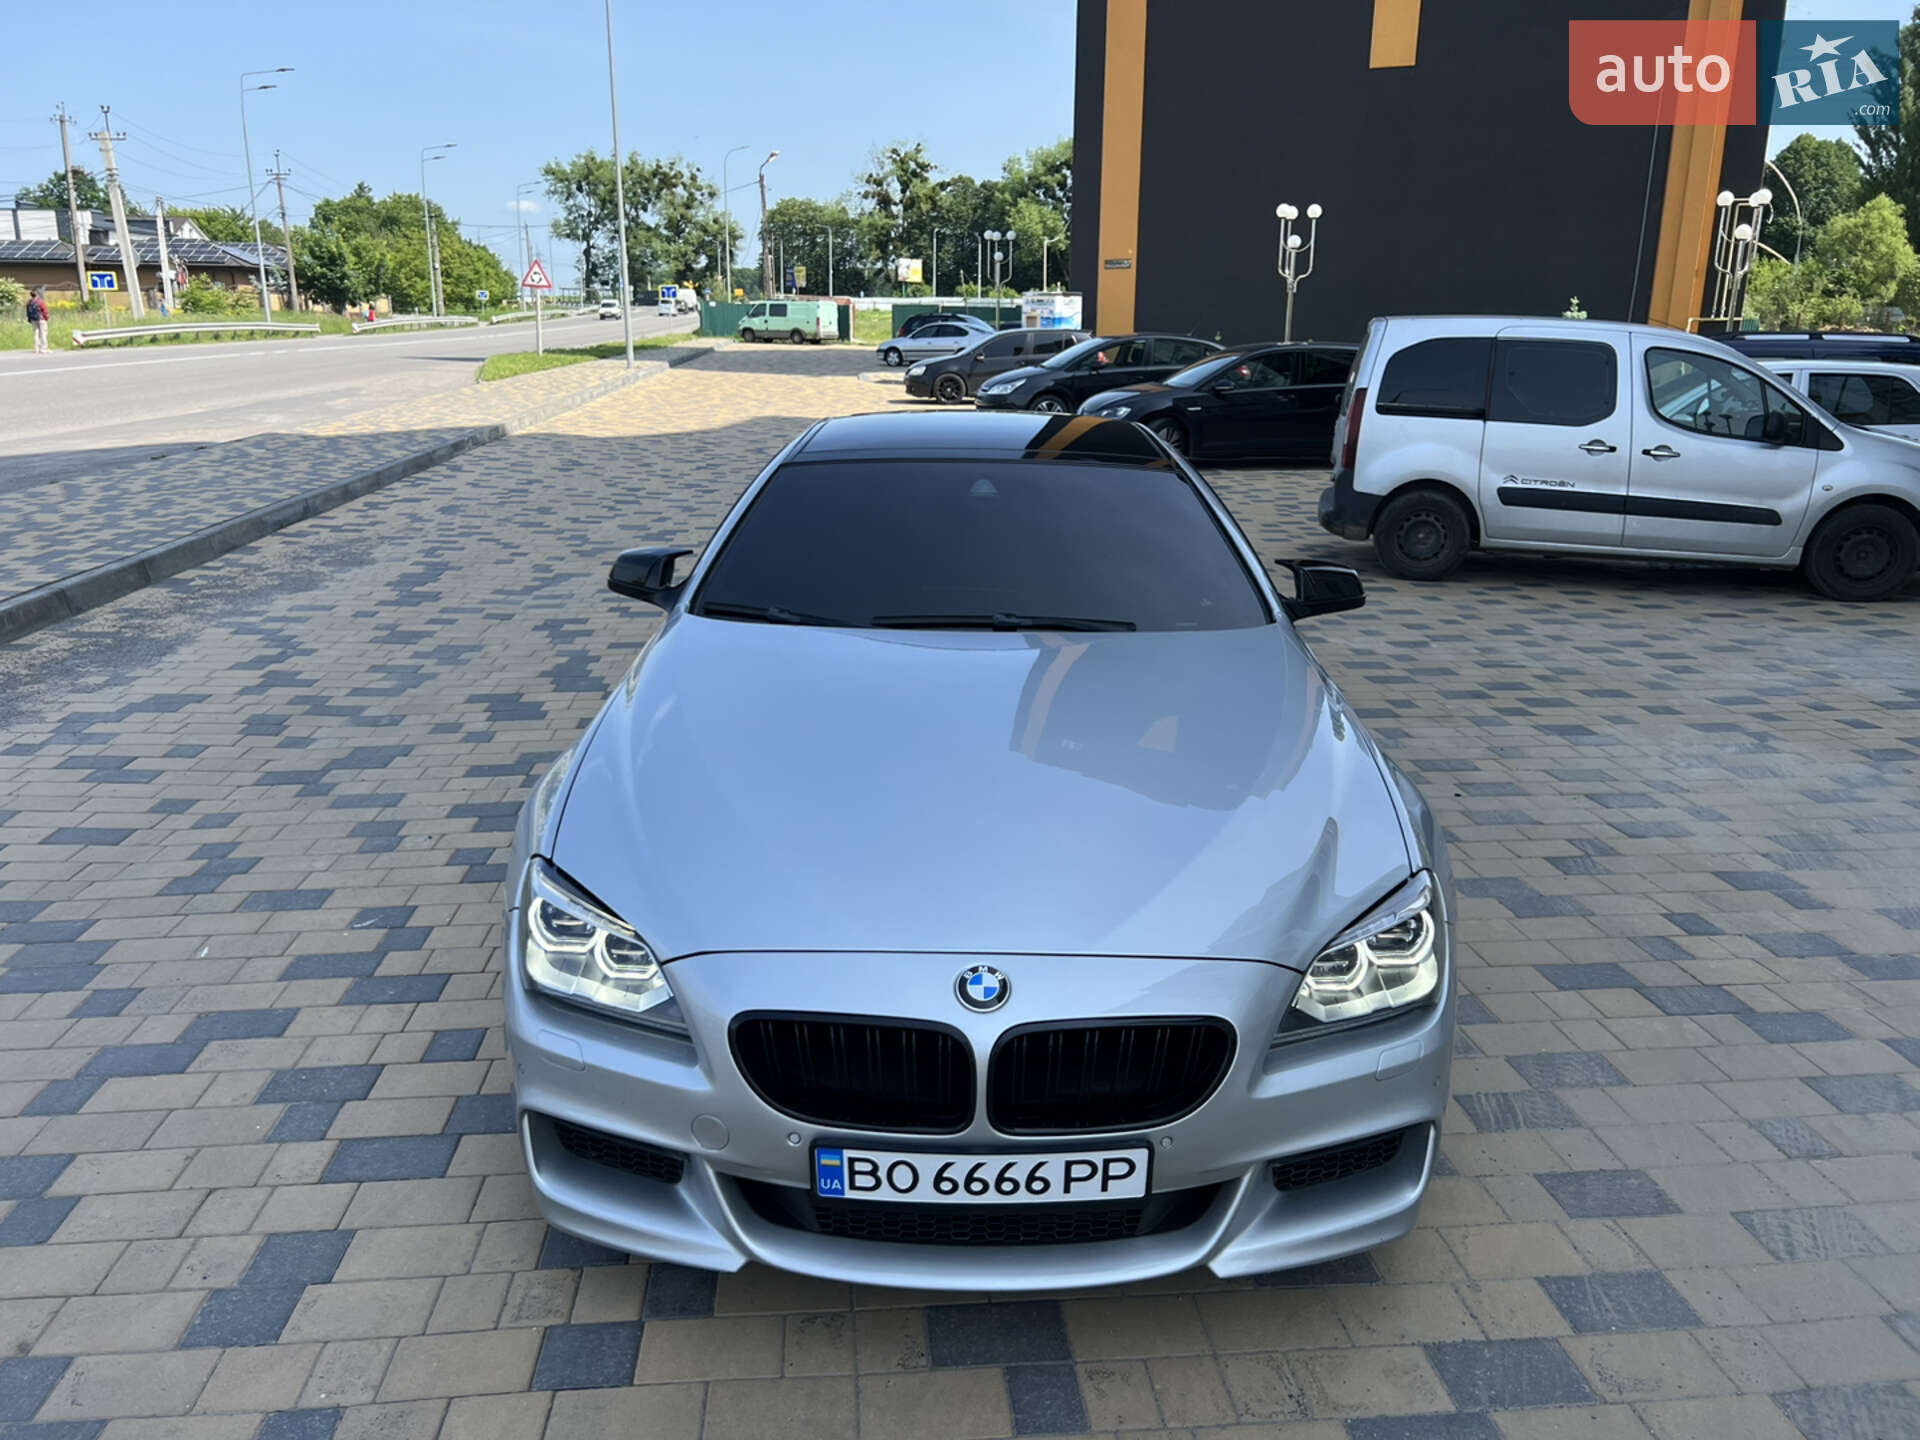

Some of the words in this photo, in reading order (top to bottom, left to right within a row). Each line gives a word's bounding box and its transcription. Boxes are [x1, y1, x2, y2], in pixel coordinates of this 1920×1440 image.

[963, 966, 1005, 980] BMW
[847, 1156, 920, 1194] BO
[933, 1160, 1051, 1196] 6666
[1062, 1156, 1137, 1194] PP
[820, 1177, 842, 1190] UA
